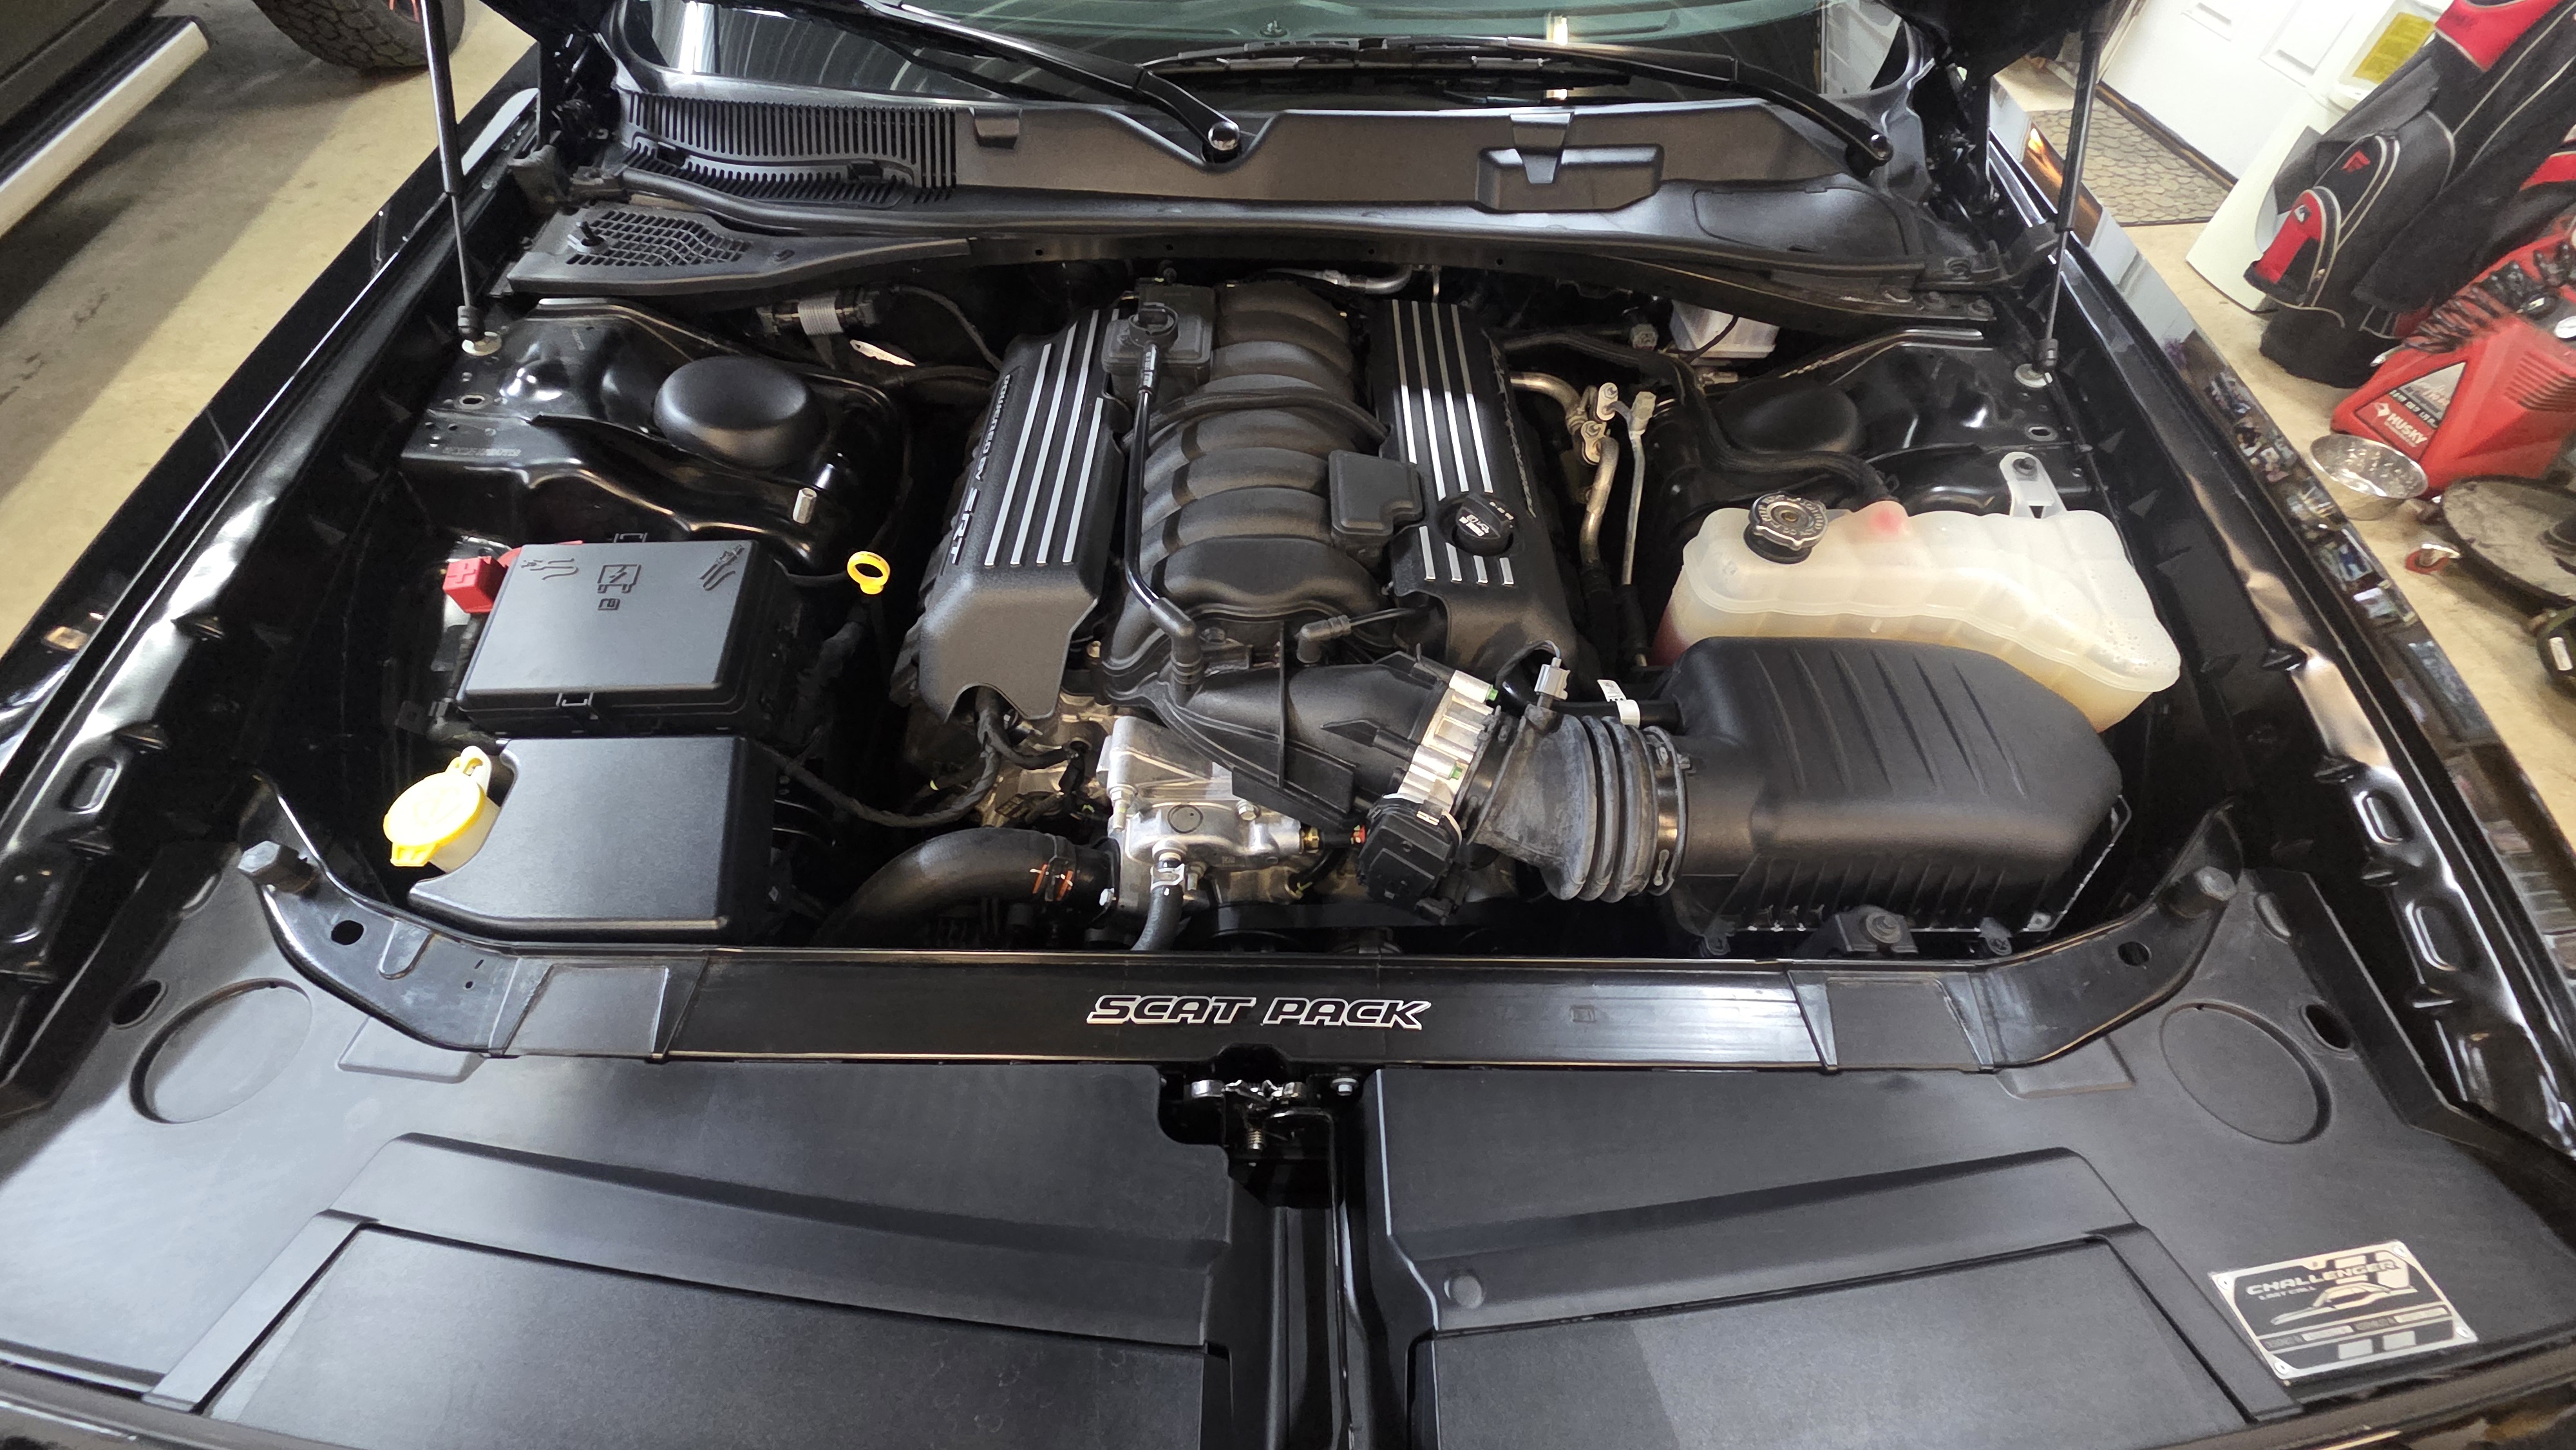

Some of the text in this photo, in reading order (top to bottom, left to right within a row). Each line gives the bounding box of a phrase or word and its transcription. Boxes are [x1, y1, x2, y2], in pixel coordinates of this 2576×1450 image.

[2386, 413, 2428, 444] HUSKY
[951, 487, 978, 565] SRT
[1086, 995, 1431, 1030] SCAT PACK
[2246, 1260, 2399, 1295] CHALLENGER
